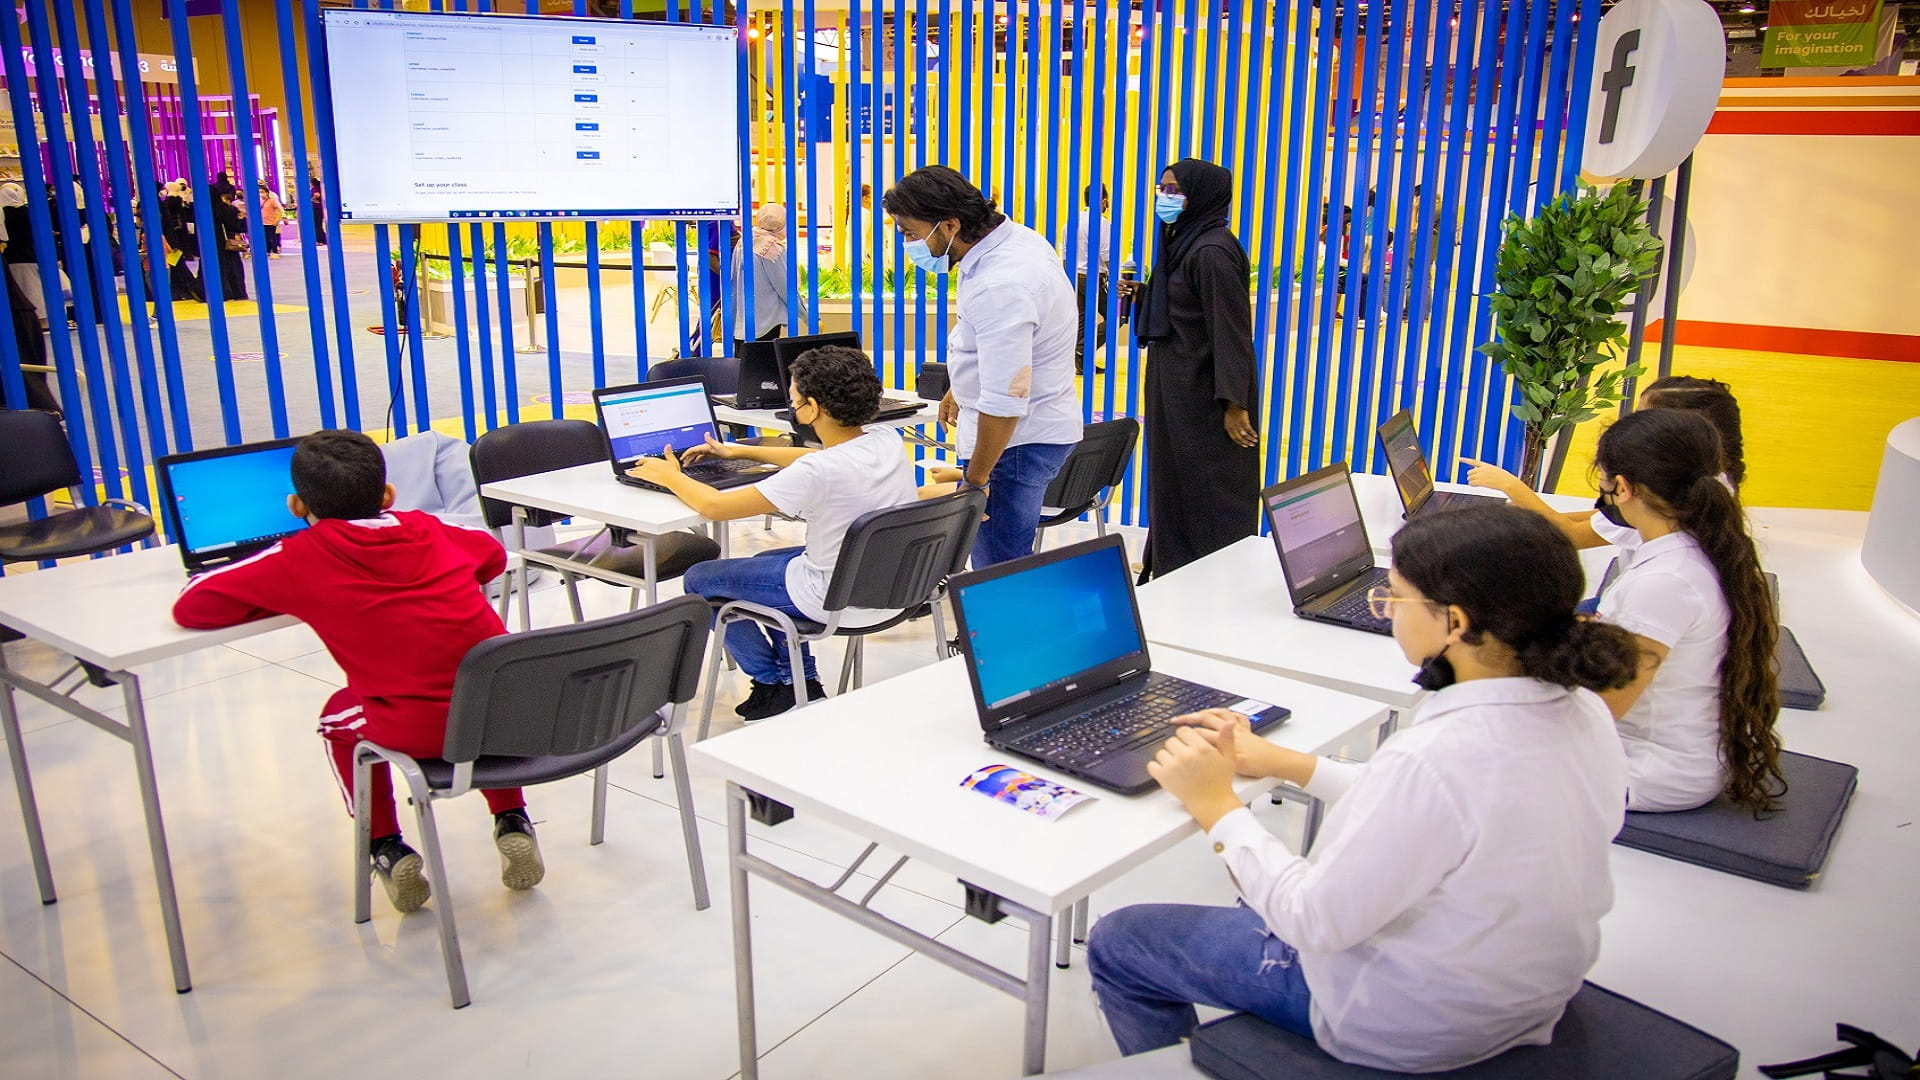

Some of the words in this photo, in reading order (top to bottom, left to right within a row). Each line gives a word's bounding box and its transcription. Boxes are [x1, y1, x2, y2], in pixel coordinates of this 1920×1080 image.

[1804, 4, 1867, 20] لخيالك
[1777, 31, 1801, 41] For
[1804, 30, 1839, 42] your
[1775, 42, 1864, 56] imagination
